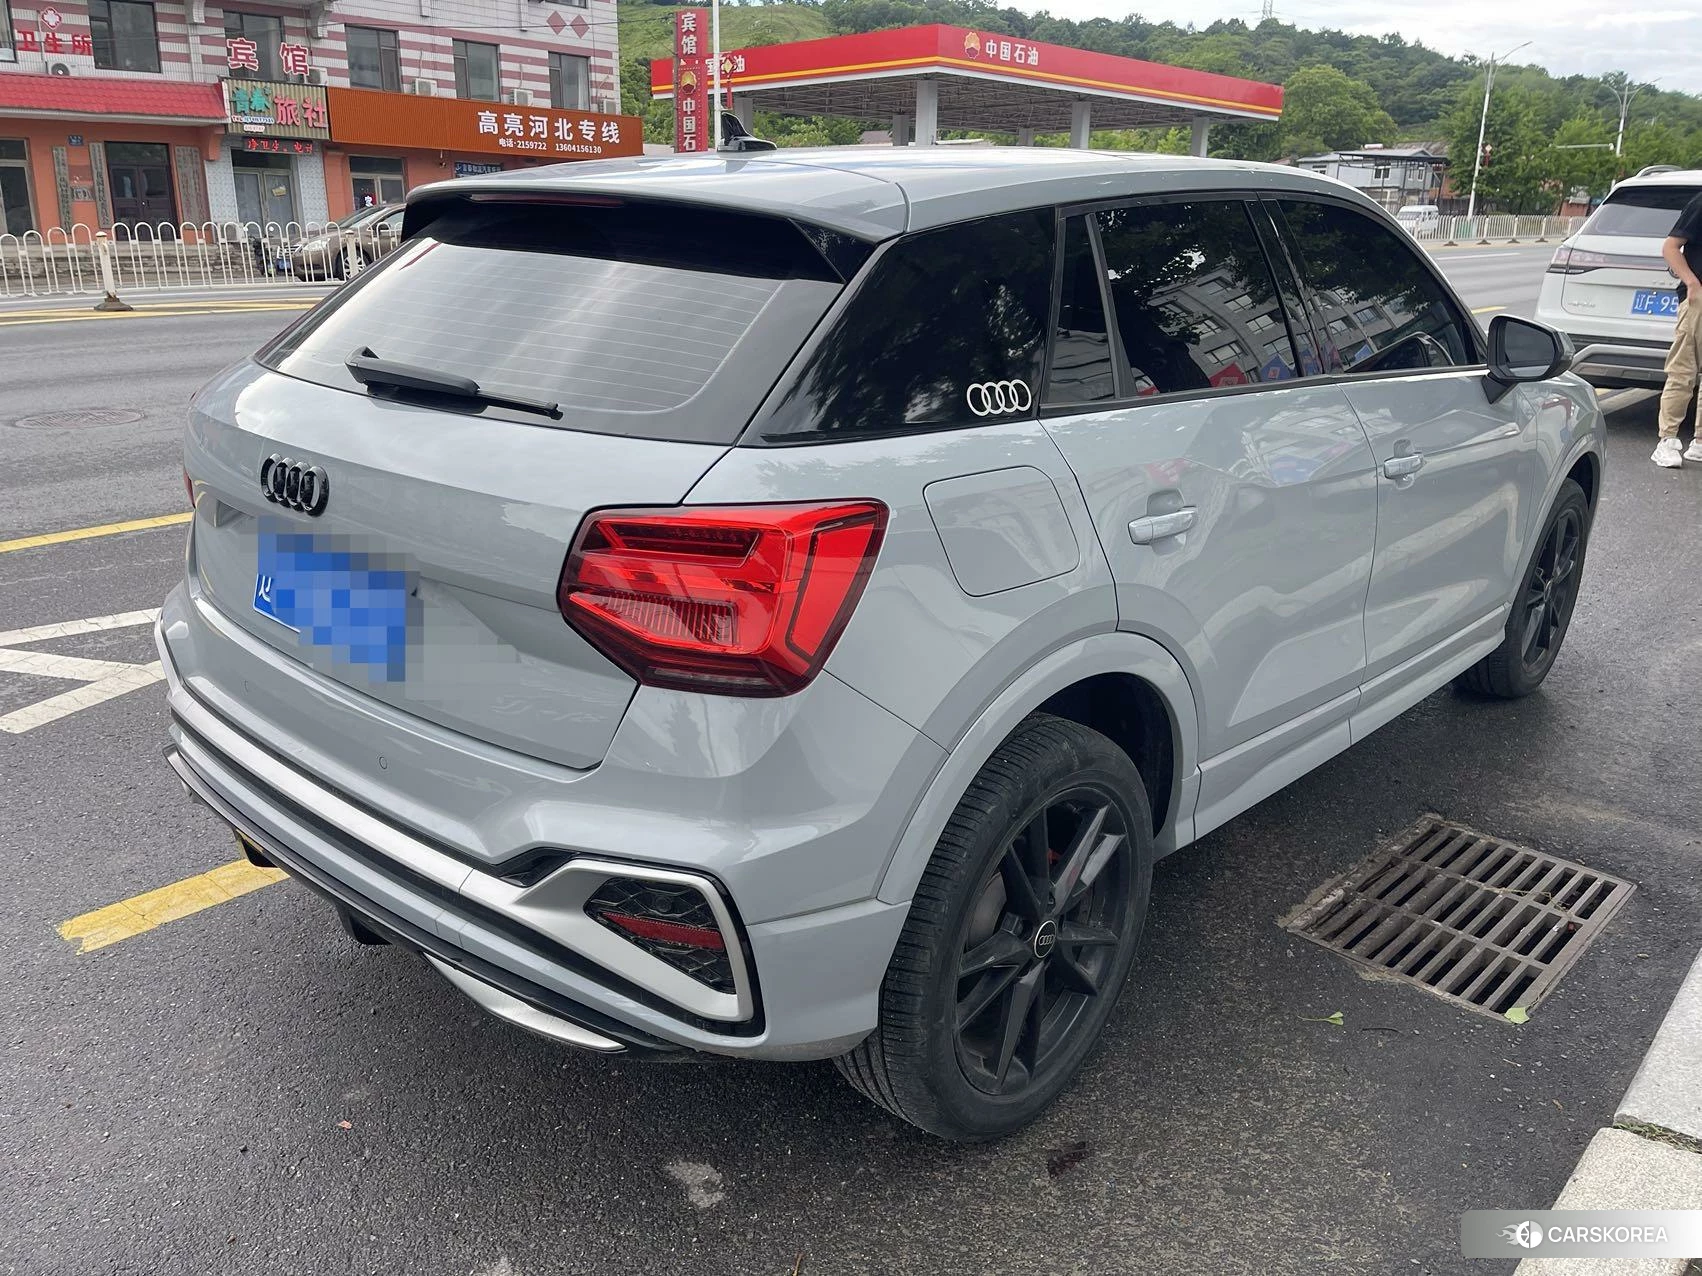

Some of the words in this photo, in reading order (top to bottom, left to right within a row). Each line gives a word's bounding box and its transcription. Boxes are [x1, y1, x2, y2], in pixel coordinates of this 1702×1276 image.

[16, 30, 92, 56] 卫生所
[681, 12, 697, 55] 宾馆
[227, 37, 309, 76] 宾馆
[985, 39, 1038, 65] 中国石油
[477, 110, 620, 144] 高亮河北专线
[555, 143, 602, 153] 13604156130
